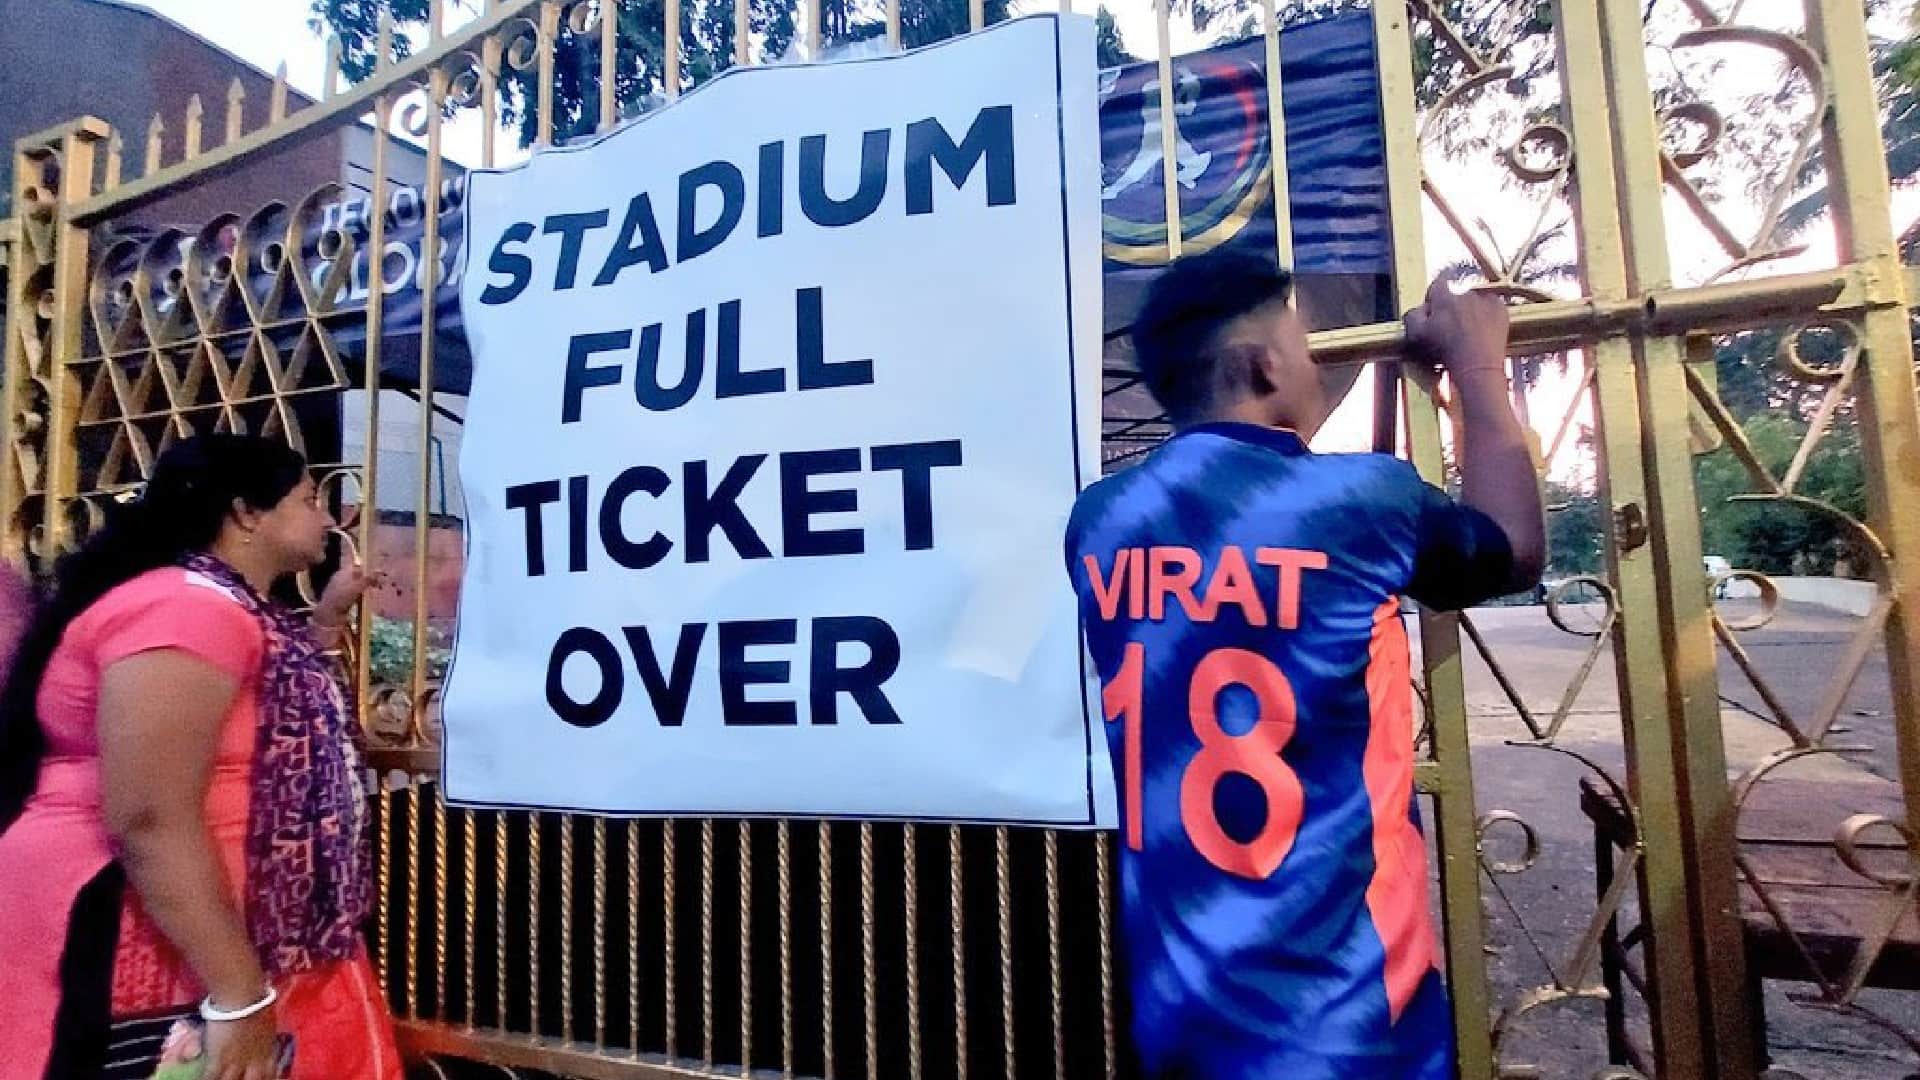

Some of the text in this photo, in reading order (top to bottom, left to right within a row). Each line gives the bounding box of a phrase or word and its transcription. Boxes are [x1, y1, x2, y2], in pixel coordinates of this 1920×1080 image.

[480, 104, 1016, 304] STADIUM
[562, 286, 874, 424] FULL
[506, 439, 962, 576] TICKET
[1083, 545, 1328, 630] VIRAT
[546, 616, 903, 728] OVER
[1102, 642, 1304, 880] 18
